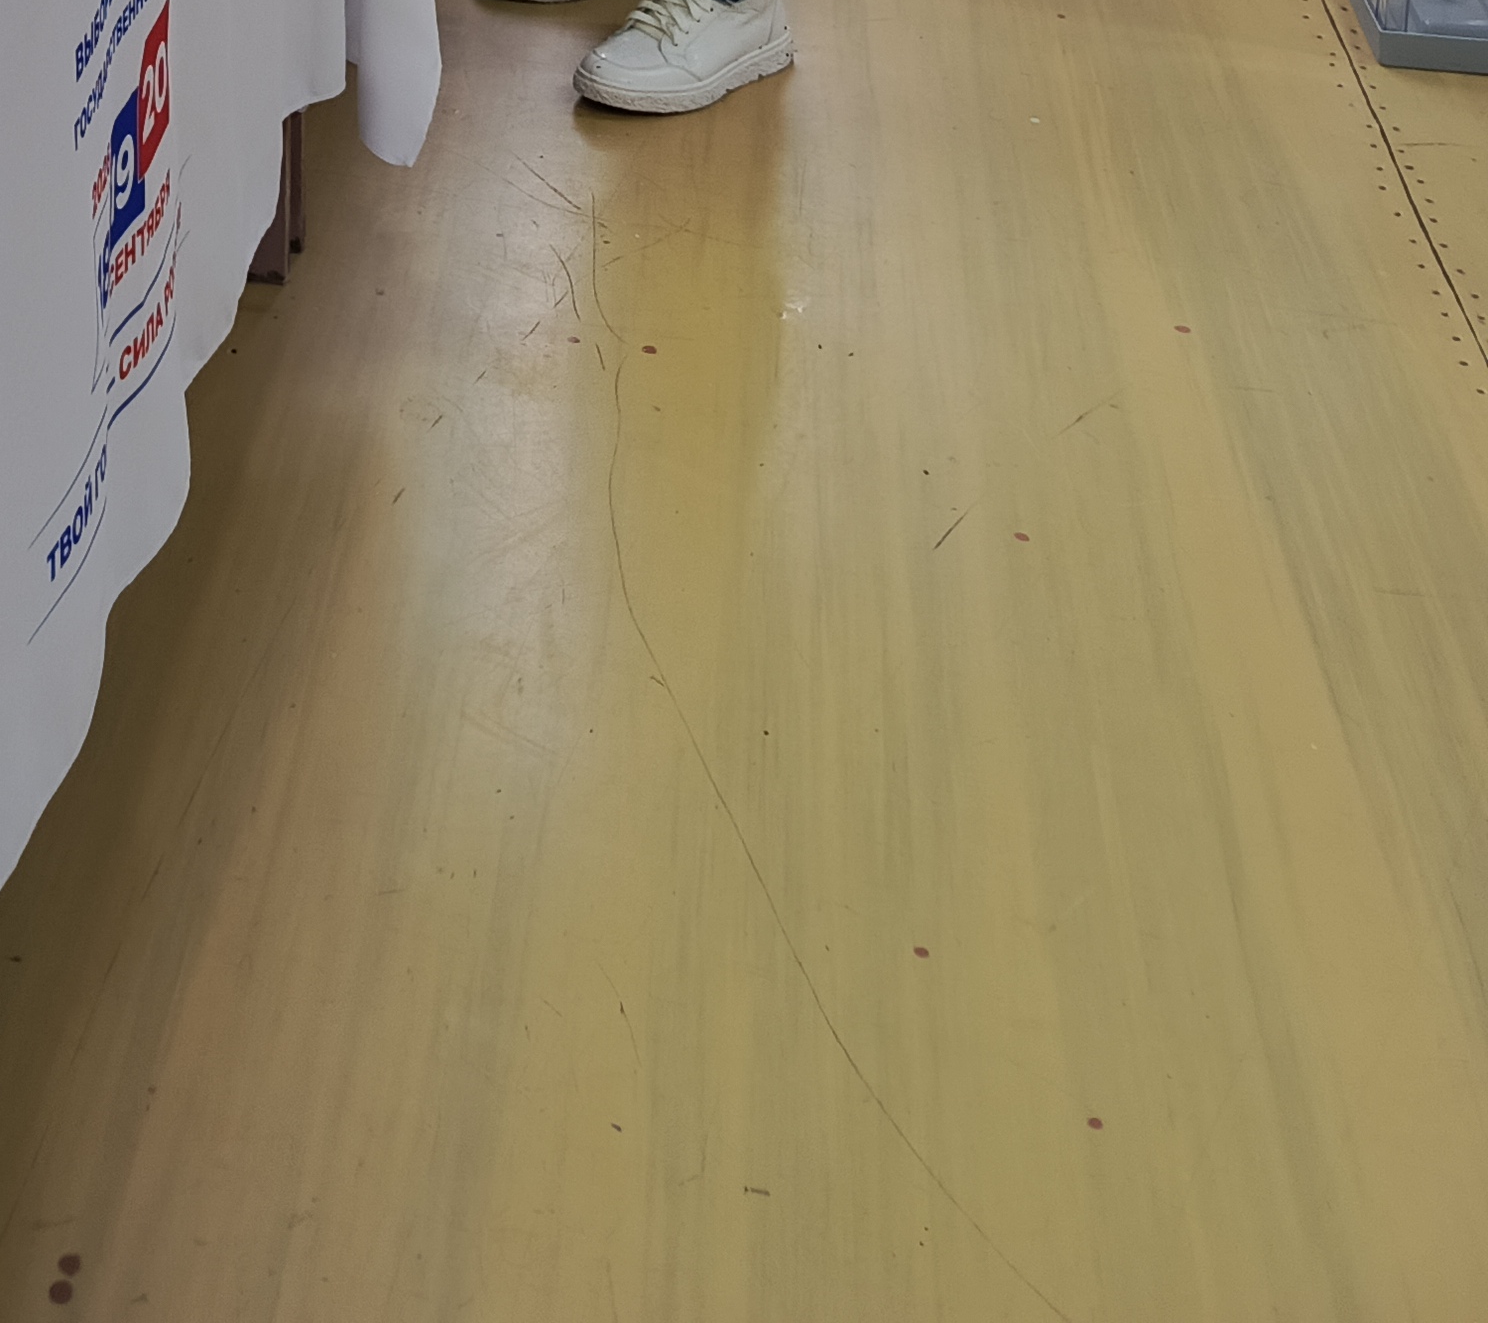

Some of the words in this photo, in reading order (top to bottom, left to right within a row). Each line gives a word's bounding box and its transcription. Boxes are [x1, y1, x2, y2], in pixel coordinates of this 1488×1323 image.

[141, 40, 168, 146] 20
[46, 474, 93, 583] ТВОЙ
[119, 302, 164, 381] СИЛА
